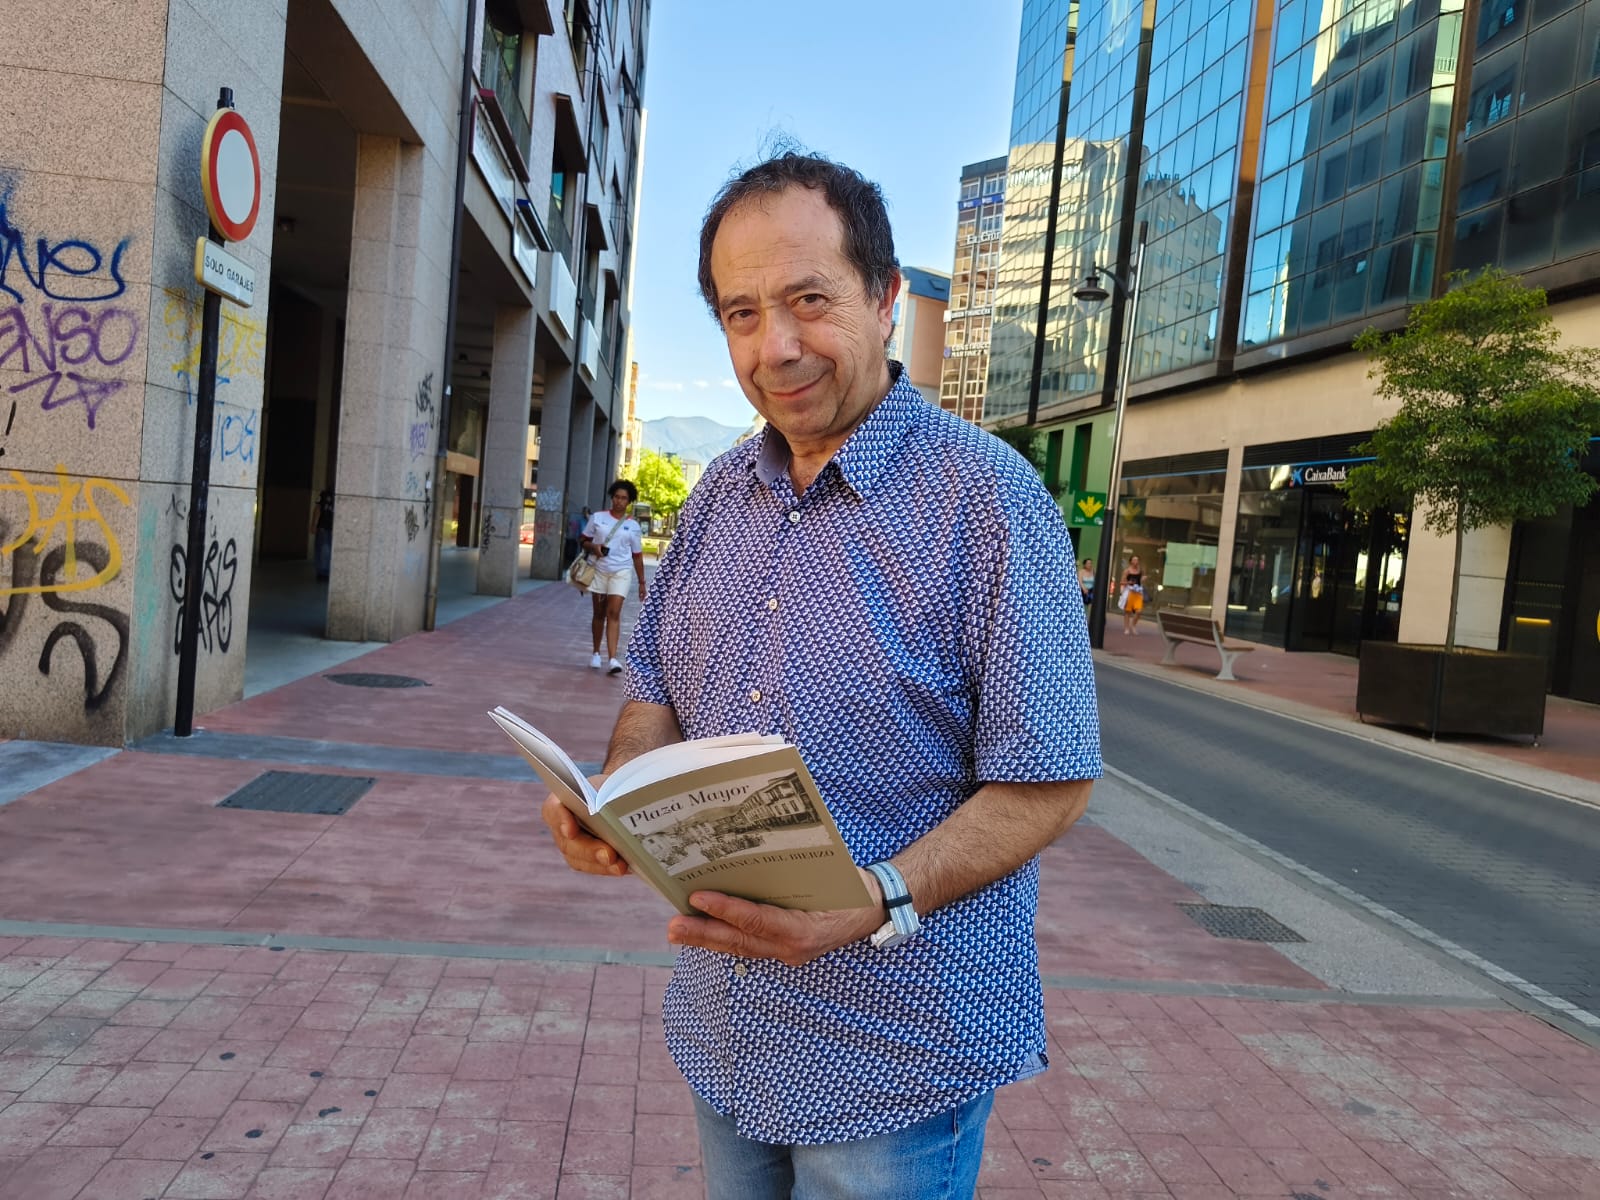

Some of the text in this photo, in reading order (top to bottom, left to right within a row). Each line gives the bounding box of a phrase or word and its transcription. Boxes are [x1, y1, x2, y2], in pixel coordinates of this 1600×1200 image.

[205, 255, 254, 293] SOLO GARAJES
[1304, 466, 1347, 481] CaixaBank
[628, 784, 750, 828] Plaza Mayor
[678, 850, 835, 882] VILLAFRANCA DEL BIERZO
